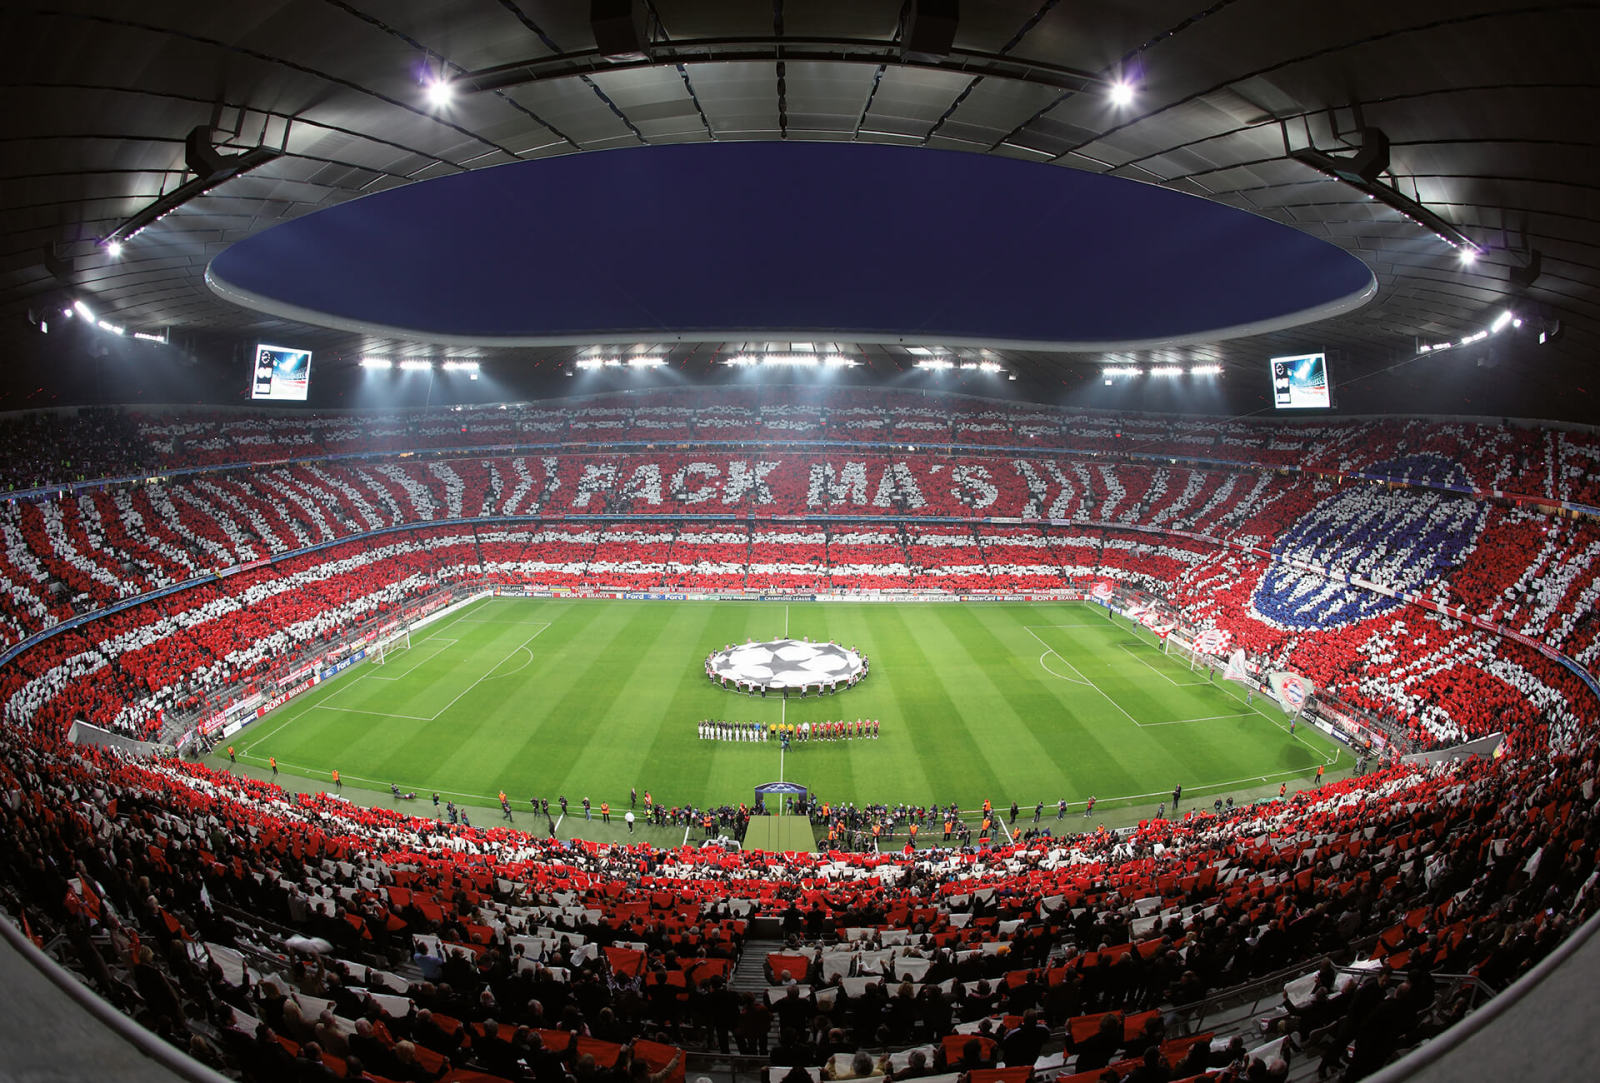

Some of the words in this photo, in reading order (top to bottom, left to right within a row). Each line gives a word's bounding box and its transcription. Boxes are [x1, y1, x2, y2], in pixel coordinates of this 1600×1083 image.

[572, 461, 781, 507] PACK
[336, 658, 351, 671] Ford
[263, 695, 287, 713] SONY
[288, 682, 310, 699] BRAVIA
